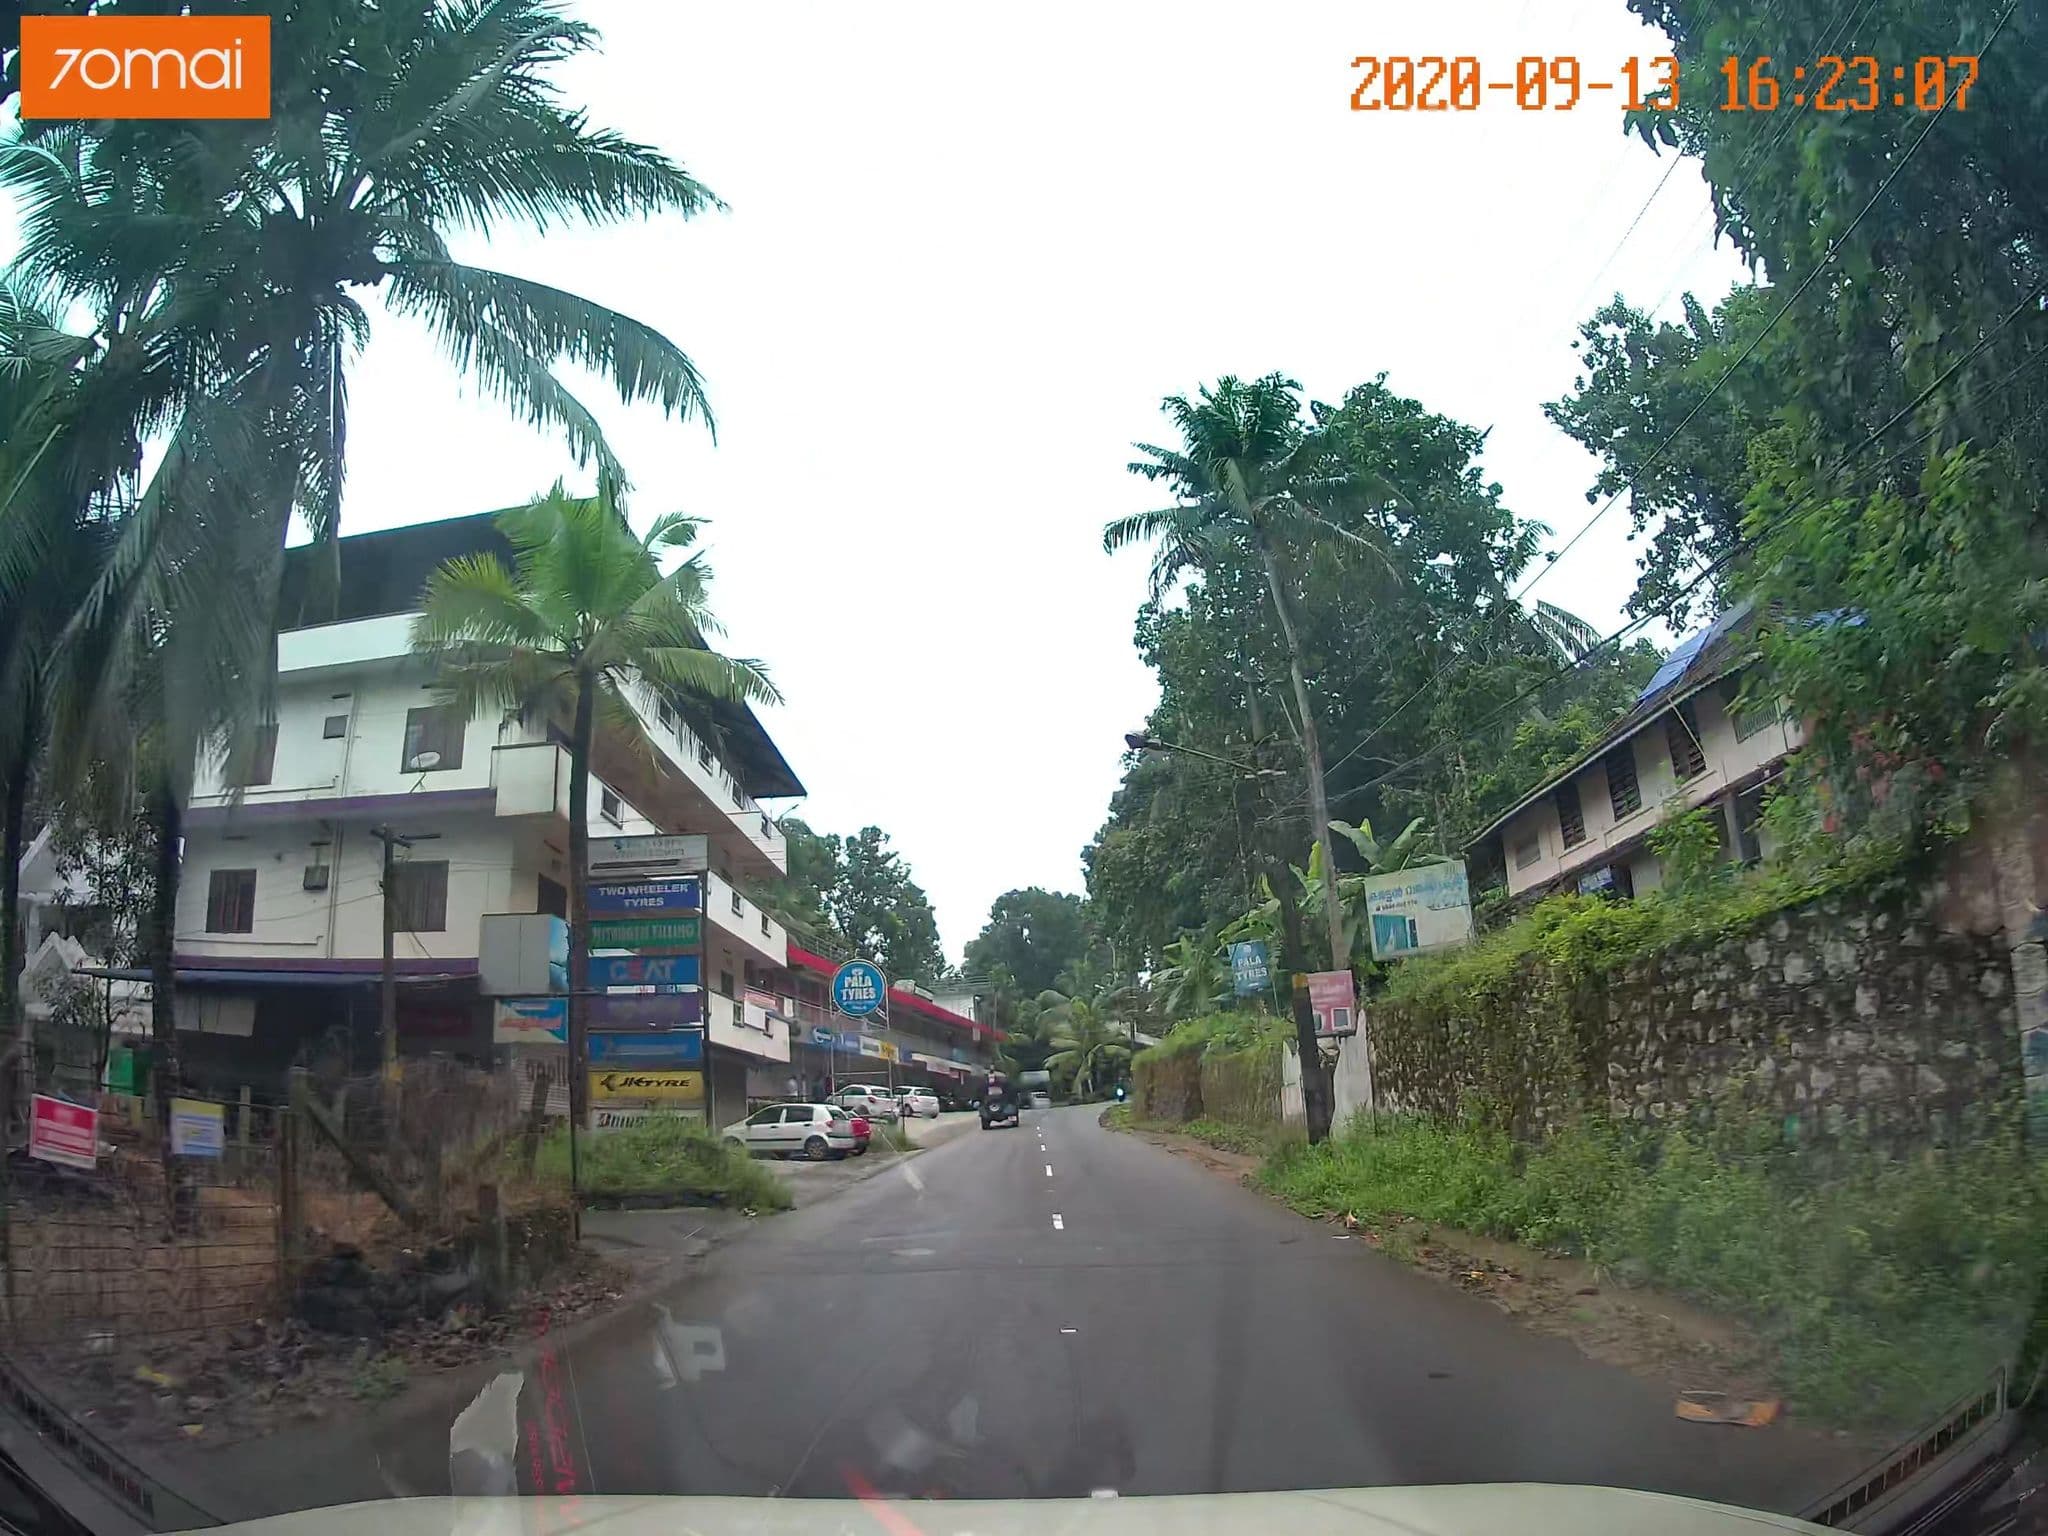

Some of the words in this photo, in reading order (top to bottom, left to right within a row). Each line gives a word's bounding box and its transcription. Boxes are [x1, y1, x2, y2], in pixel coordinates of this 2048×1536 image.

[599, 887, 626, 896] TWO
[627, 883, 690, 895] WHEELER
[624, 897, 664, 907] TYRES
[1235, 966, 1268, 981] TYRES
[844, 975, 873, 988] PALA
[840, 987, 877, 1001] TYRES
